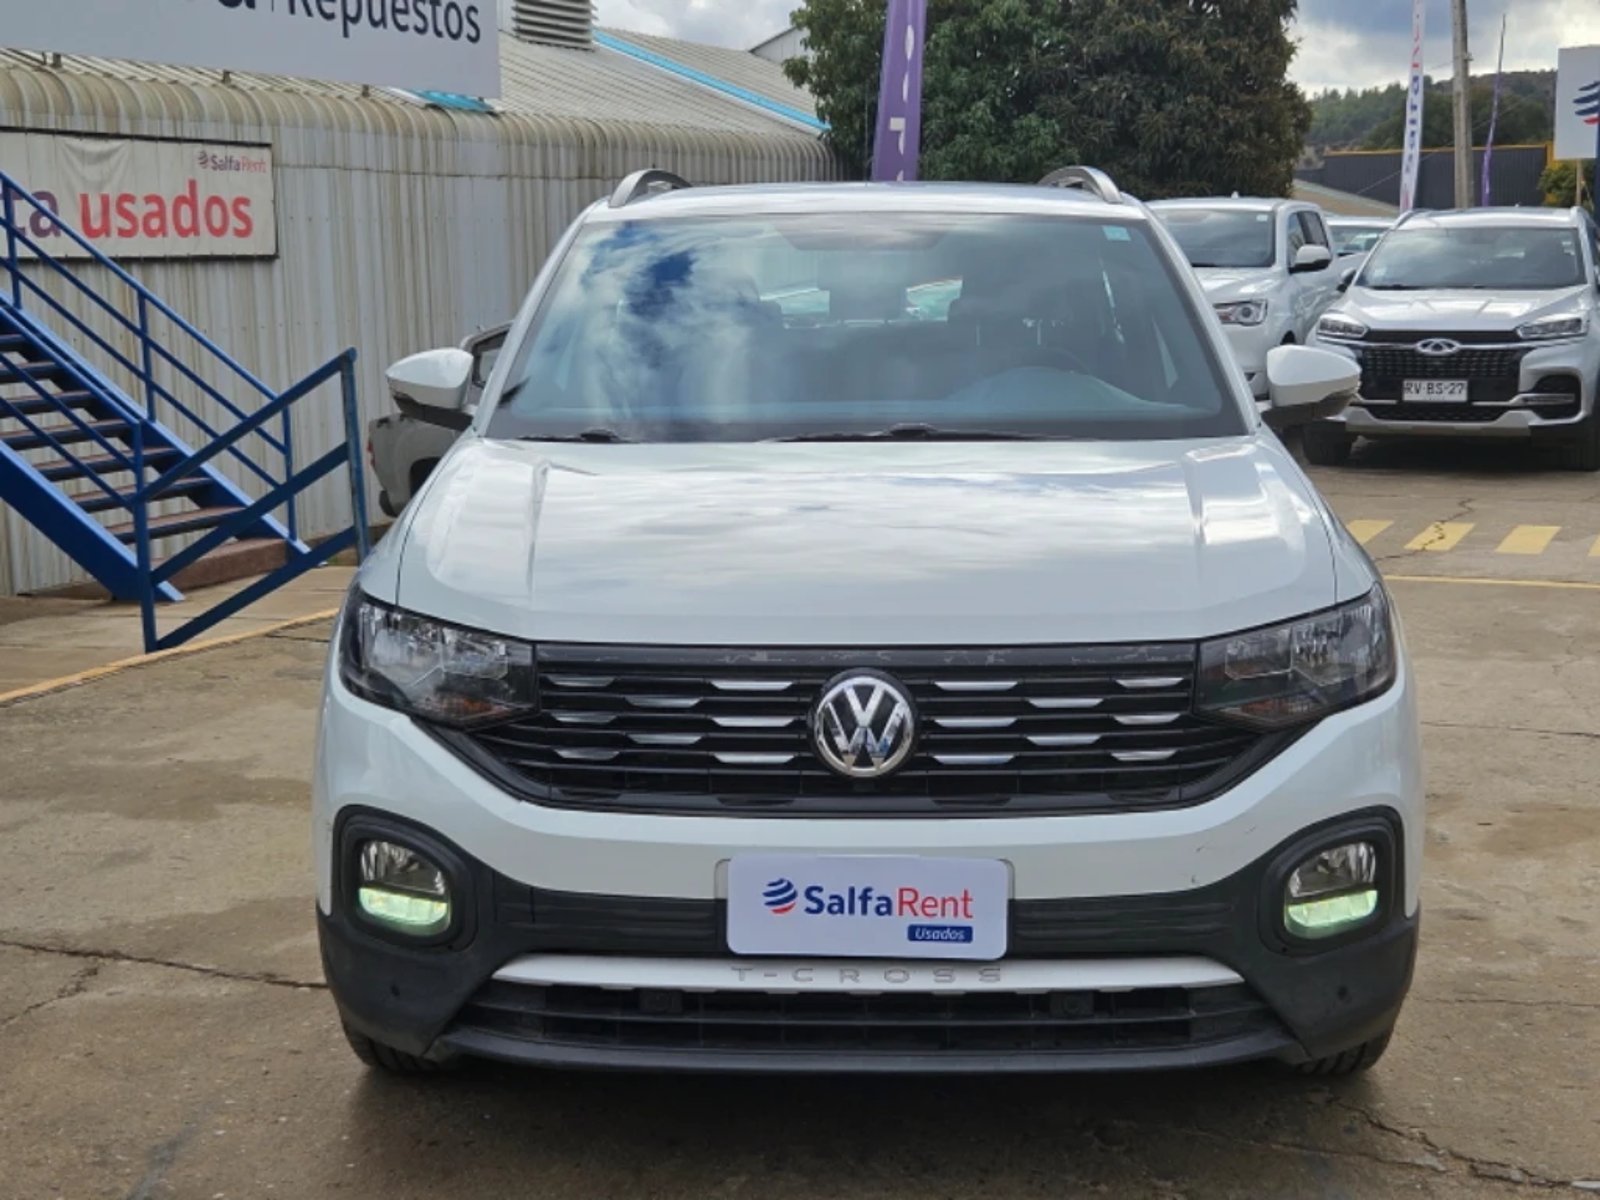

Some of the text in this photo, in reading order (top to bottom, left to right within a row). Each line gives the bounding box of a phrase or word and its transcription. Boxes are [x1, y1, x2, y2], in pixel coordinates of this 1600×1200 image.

[79, 178, 253, 239] usados
[804, 885, 973, 919] SalfaRent
[915, 928, 965, 940] Usados
[731, 966, 1001, 984] T-CROSS
